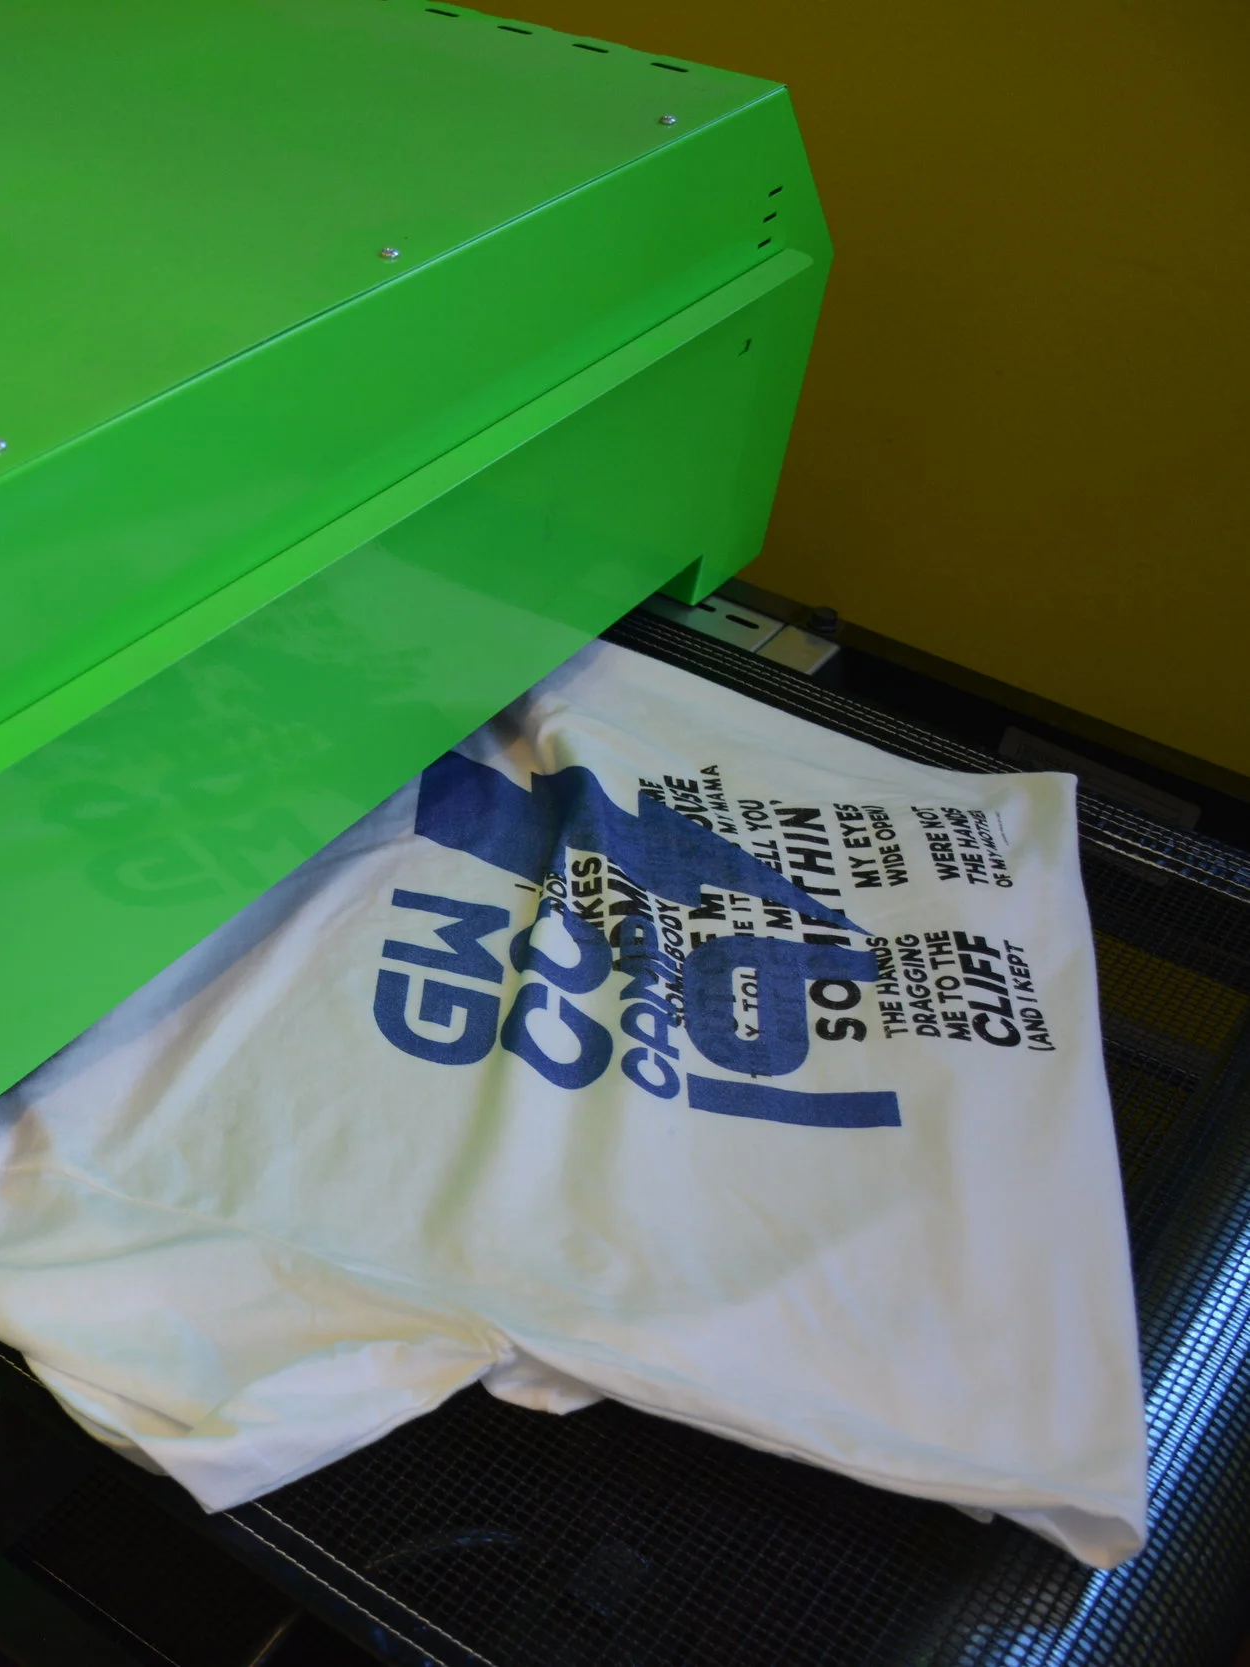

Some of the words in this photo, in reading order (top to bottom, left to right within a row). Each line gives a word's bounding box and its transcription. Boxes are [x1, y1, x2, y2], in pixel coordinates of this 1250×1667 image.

[700, 764, 730, 813] MAMA
[737, 799, 773, 831] YOU
[833, 802, 872, 848] EYES
[940, 806, 980, 850] HANDS
[848, 856, 882, 888] MY
[879, 843, 909, 887] WIDE
[925, 832, 961, 881] WERE
[960, 853, 990, 885] THE
[987, 852, 1007, 870] MY
[993, 872, 1014, 888] OF
[729, 893, 752, 912] IT
[865, 936, 901, 995] HANDS
[923, 930, 956, 972] THE
[1003, 939, 1036, 993] KEPT
[373, 888, 511, 1066] GW
[895, 933, 942, 1038] DRAGGING
[934, 975, 964, 1004] TO
[953, 931, 1022, 1048] CLIFF
[620, 914, 683, 1099] CAMP
[879, 1000, 909, 1039] THE
[941, 1010, 972, 1042] ME
[1019, 1005, 1057, 1052] (AND
